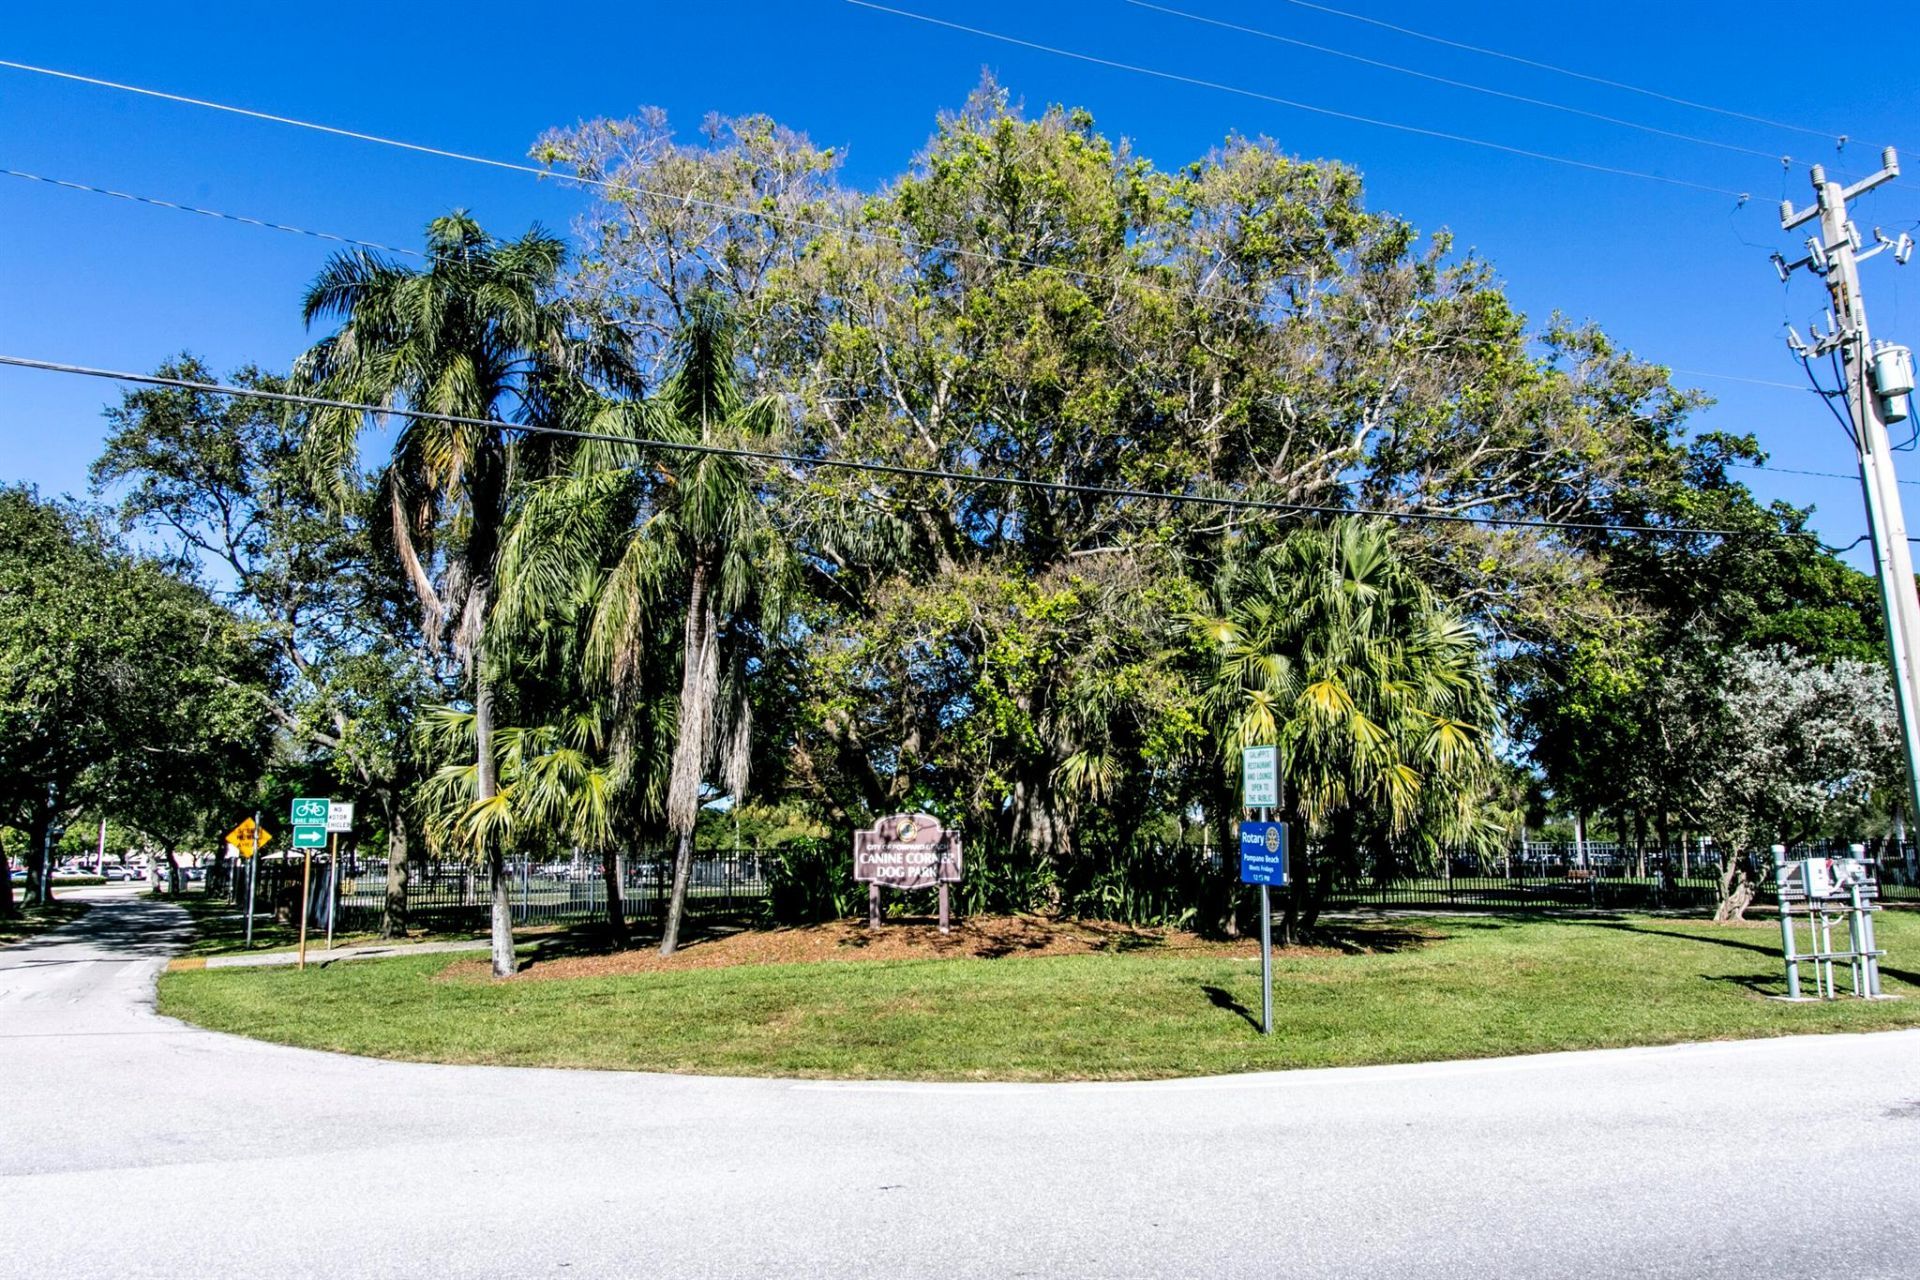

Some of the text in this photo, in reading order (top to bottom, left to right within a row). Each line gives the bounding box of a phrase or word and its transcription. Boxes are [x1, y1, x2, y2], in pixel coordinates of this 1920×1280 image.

[1248, 761, 1272, 770] RESTAURANT
[1248, 772, 1272, 780] AND LOUNGE
[1242, 832, 1264, 846] Rotary
[860, 853, 903, 864] CANINE
[1244, 853, 1280, 864] Pompano Beach
[876, 866, 938, 878] DOG PARK
[1261, 865, 1274, 873] Fridays
